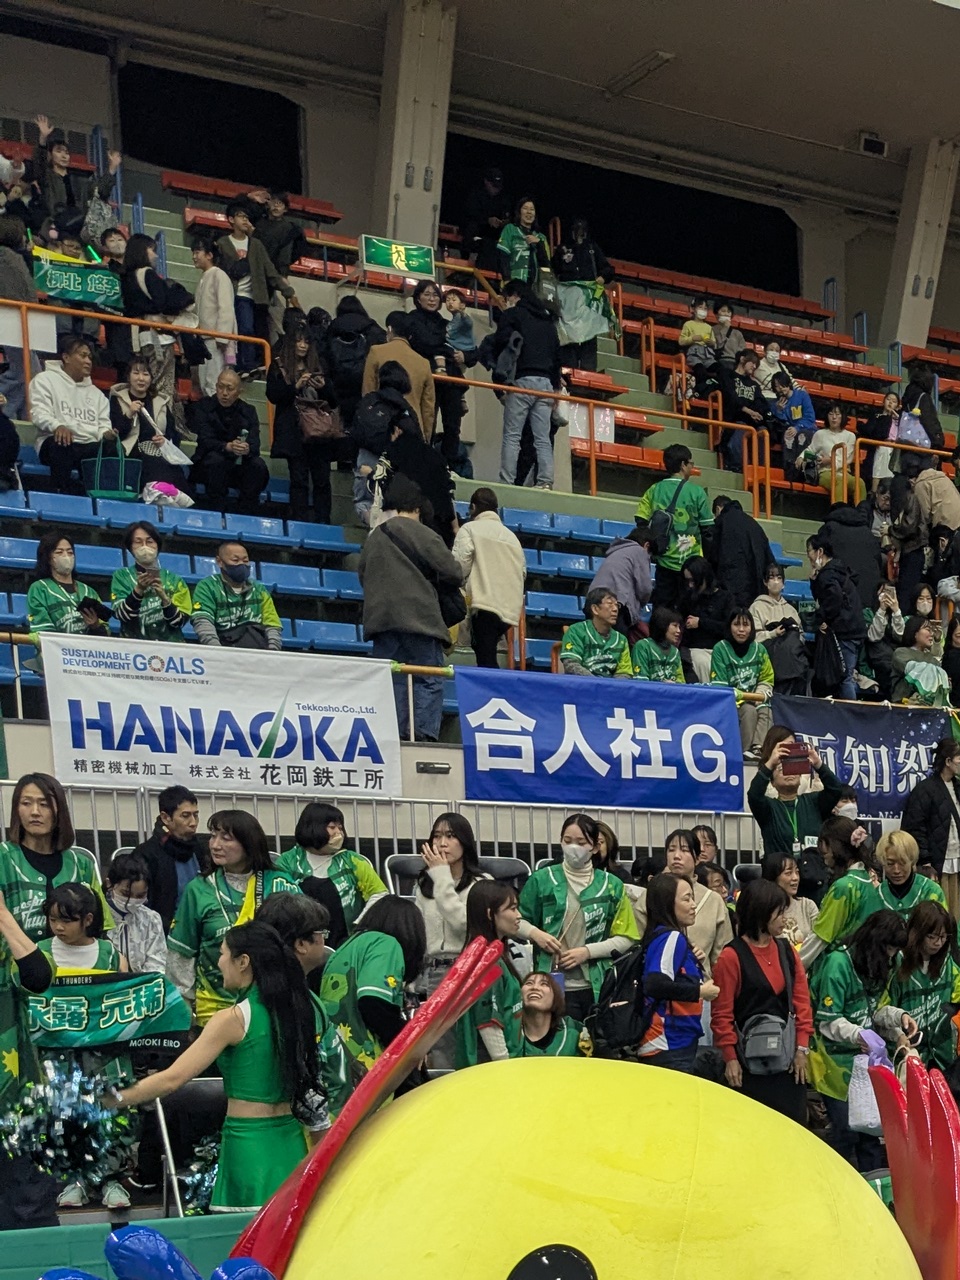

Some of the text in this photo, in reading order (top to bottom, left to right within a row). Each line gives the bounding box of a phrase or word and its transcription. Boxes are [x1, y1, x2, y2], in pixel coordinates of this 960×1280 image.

[60, 400, 97, 422] PARIS
[61, 647, 131, 661] SUSTAINABLE
[62, 658, 131, 671] DEVELOPMENT
[133, 654, 205, 676] GOALS
[67, 699, 385, 765] HANAOKA
[465, 697, 740, 787] 合人社G.
[73, 758, 385, 791] 精密機械加工 株式会社 花岡鉄工所
[62, 976, 93, 985] THUNDERS
[129, 1038, 181, 1049] MOTOKI EIRO
